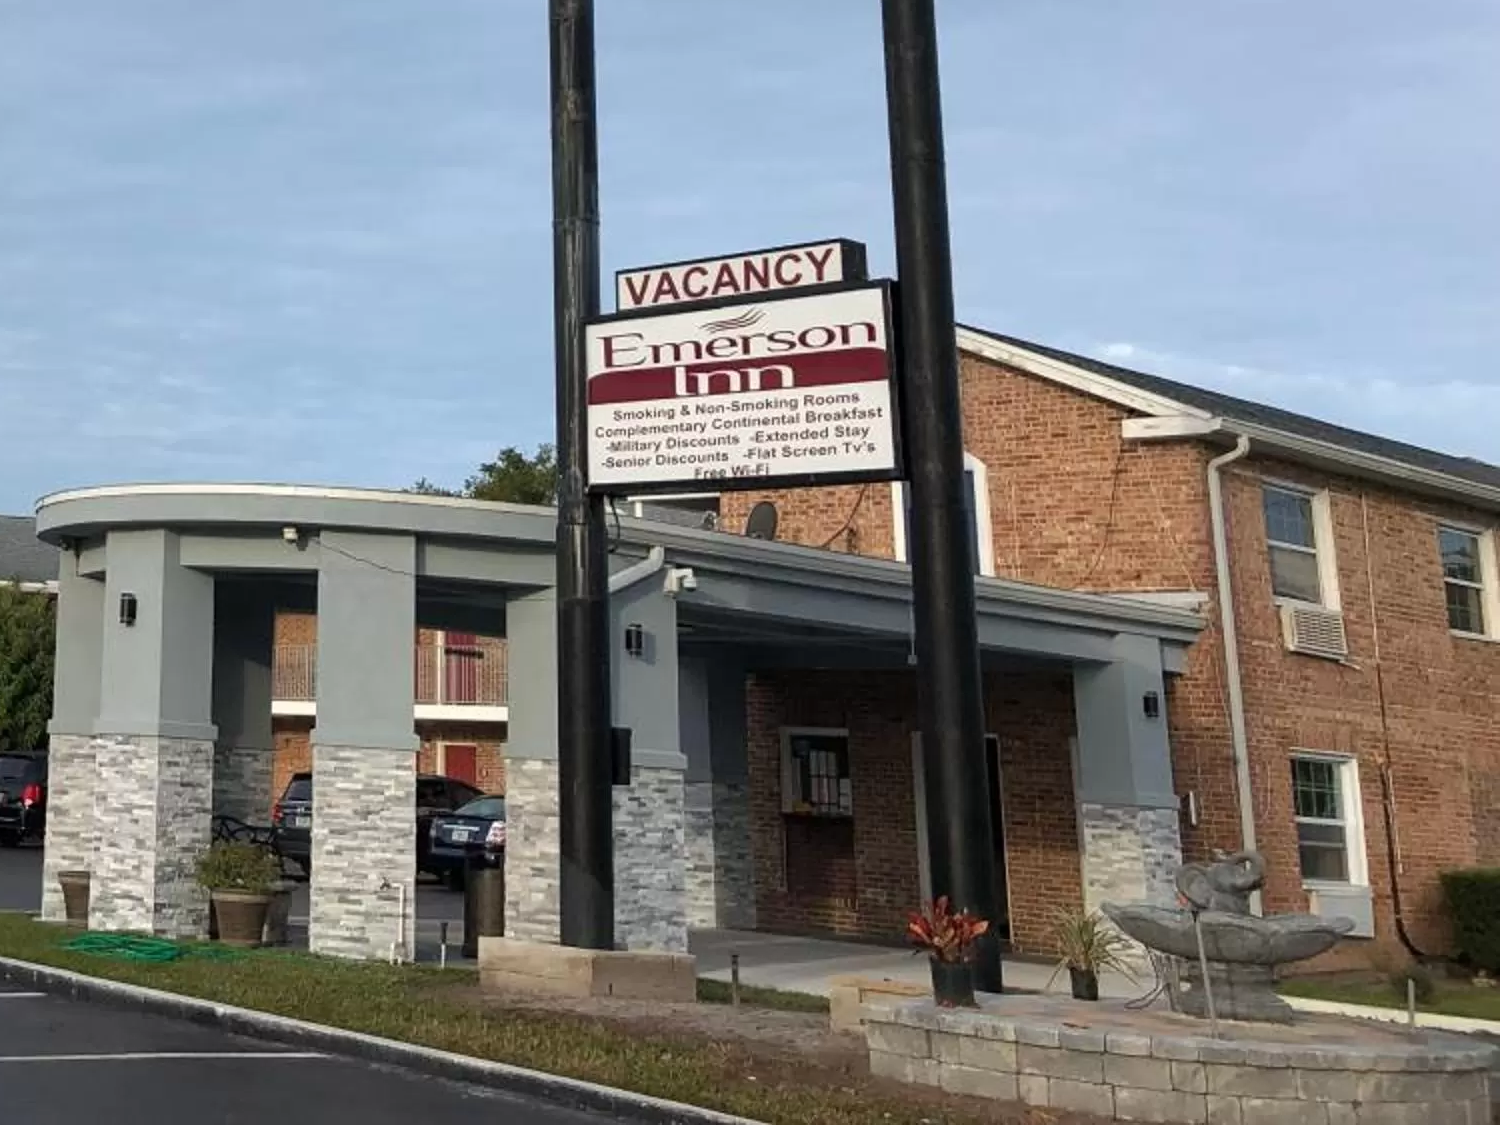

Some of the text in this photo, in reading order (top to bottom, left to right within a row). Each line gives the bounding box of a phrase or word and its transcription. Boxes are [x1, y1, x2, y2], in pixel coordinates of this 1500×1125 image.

[625, 248, 834, 305] VACANCY
[597, 321, 877, 369] Emerson
[674, 363, 795, 396] Inn
[595, 406, 883, 439] Complementary Continental Breakfast
[613, 393, 861, 421] Smoking & Non-Smoking Rooms
[601, 455, 652, 468] -Senior
[655, 451, 729, 466] Discounts
[781, 445, 837, 458] Screen
[842, 440, 877, 454] Tv's
[605, 424, 871, 453] -Military Discounts -Extended Stay
[694, 462, 769, 479] Free Wi-Fi
